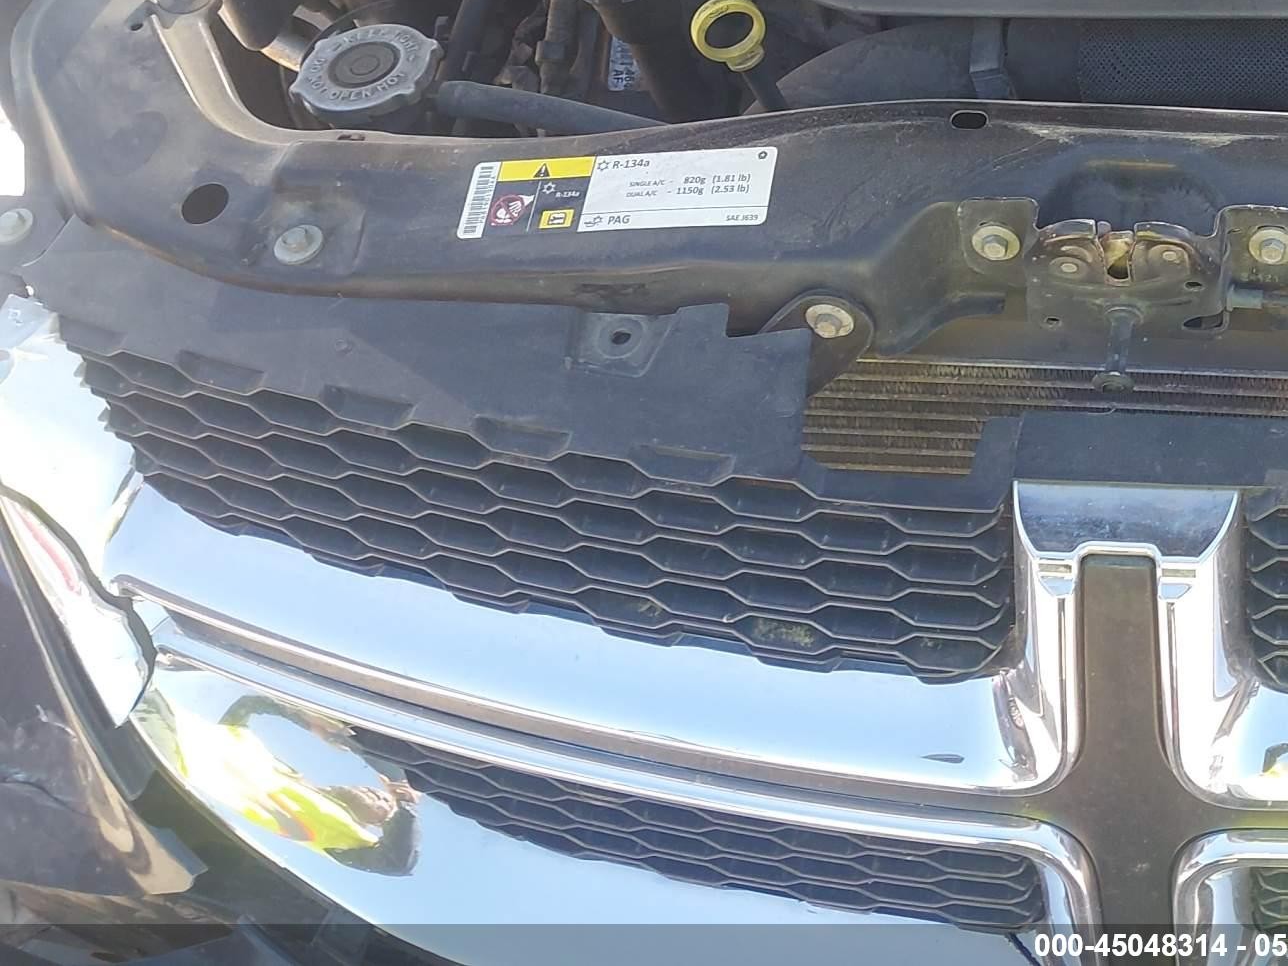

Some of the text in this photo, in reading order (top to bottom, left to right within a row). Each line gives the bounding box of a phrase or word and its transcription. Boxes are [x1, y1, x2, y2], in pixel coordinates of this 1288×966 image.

[376, 72, 406, 93] HOT
[613, 158, 650, 170] R-134a
[683, 175, 706, 185] 820g
[712, 174, 736, 184] (1.81
[737, 173, 751, 183] lb)
[676, 186, 704, 196] 1150g
[711, 185, 735, 195] (2.53
[736, 184, 750, 194] lb)
[607, 215, 631, 225] PAG
[739, 214, 759, 222] J639
